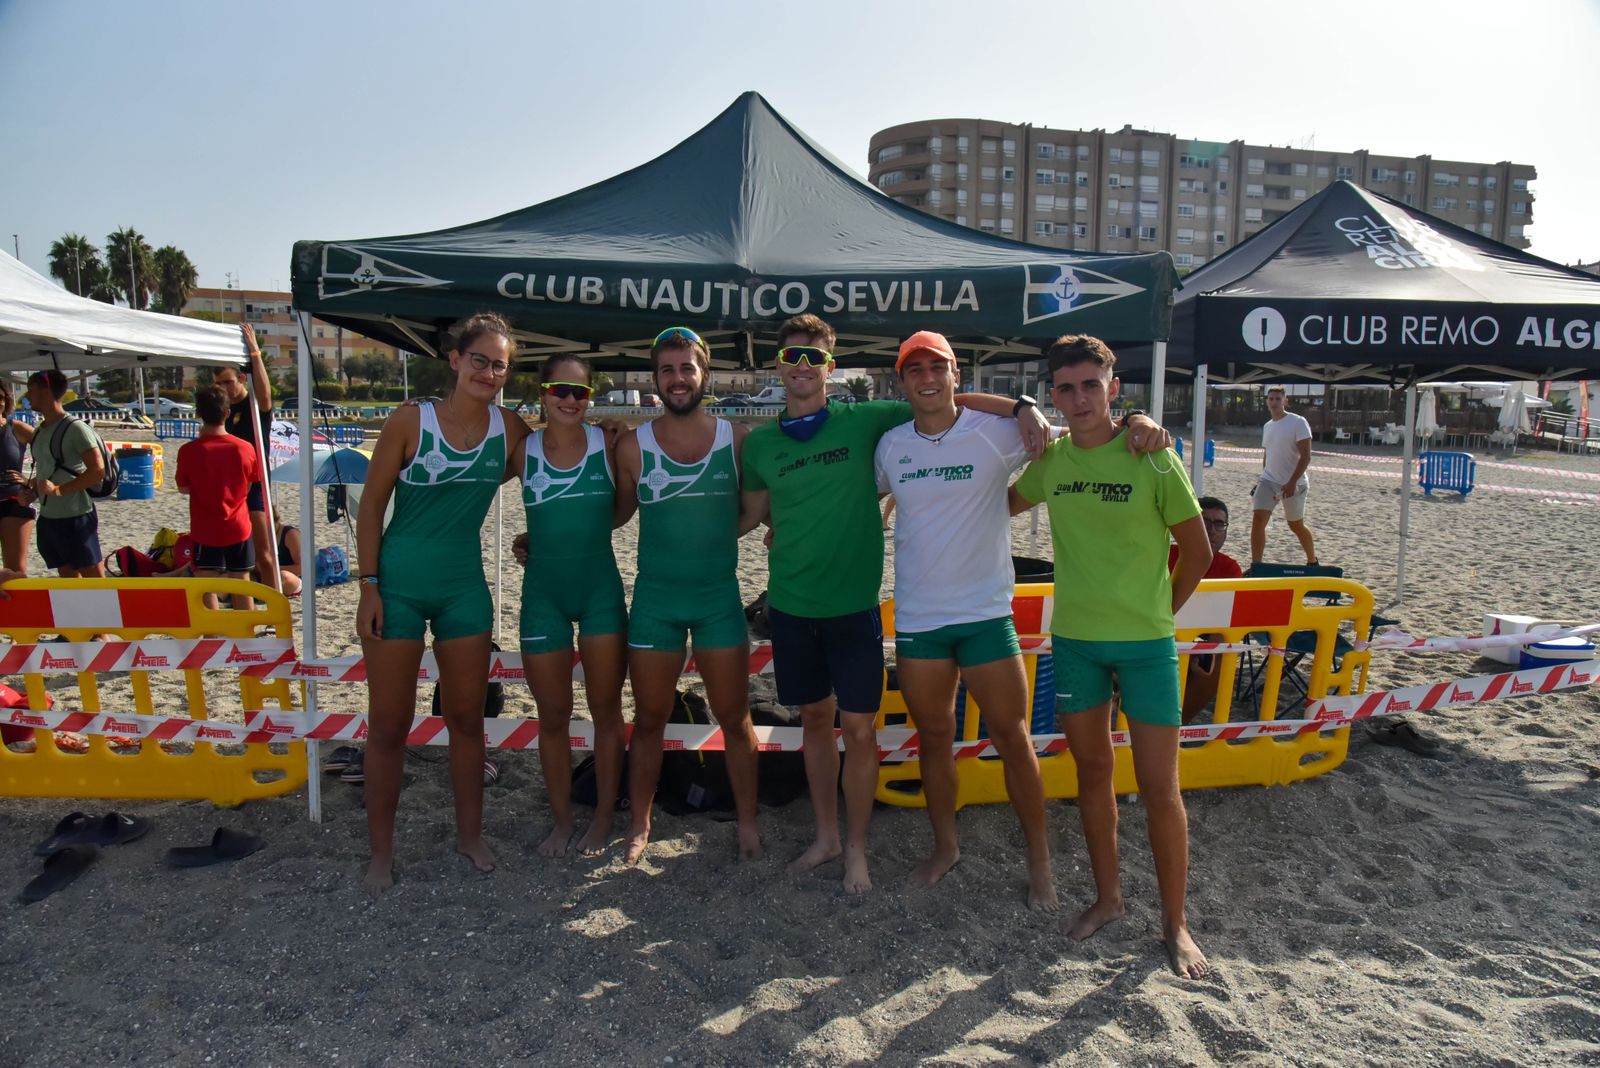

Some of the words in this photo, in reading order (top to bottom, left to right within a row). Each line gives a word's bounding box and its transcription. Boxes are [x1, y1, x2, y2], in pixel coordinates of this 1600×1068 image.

[496, 272, 605, 304] CLUB
[619, 277, 810, 319] NAUTICO
[823, 279, 980, 313] SEVILLA
[1299, 314, 1388, 345] CLUB
[1401, 315, 1500, 346] REMO
[1516, 316, 1600, 350] ALG
[944, 473, 972, 482] SEVILLA
[1101, 494, 1129, 503] SEVILLA
